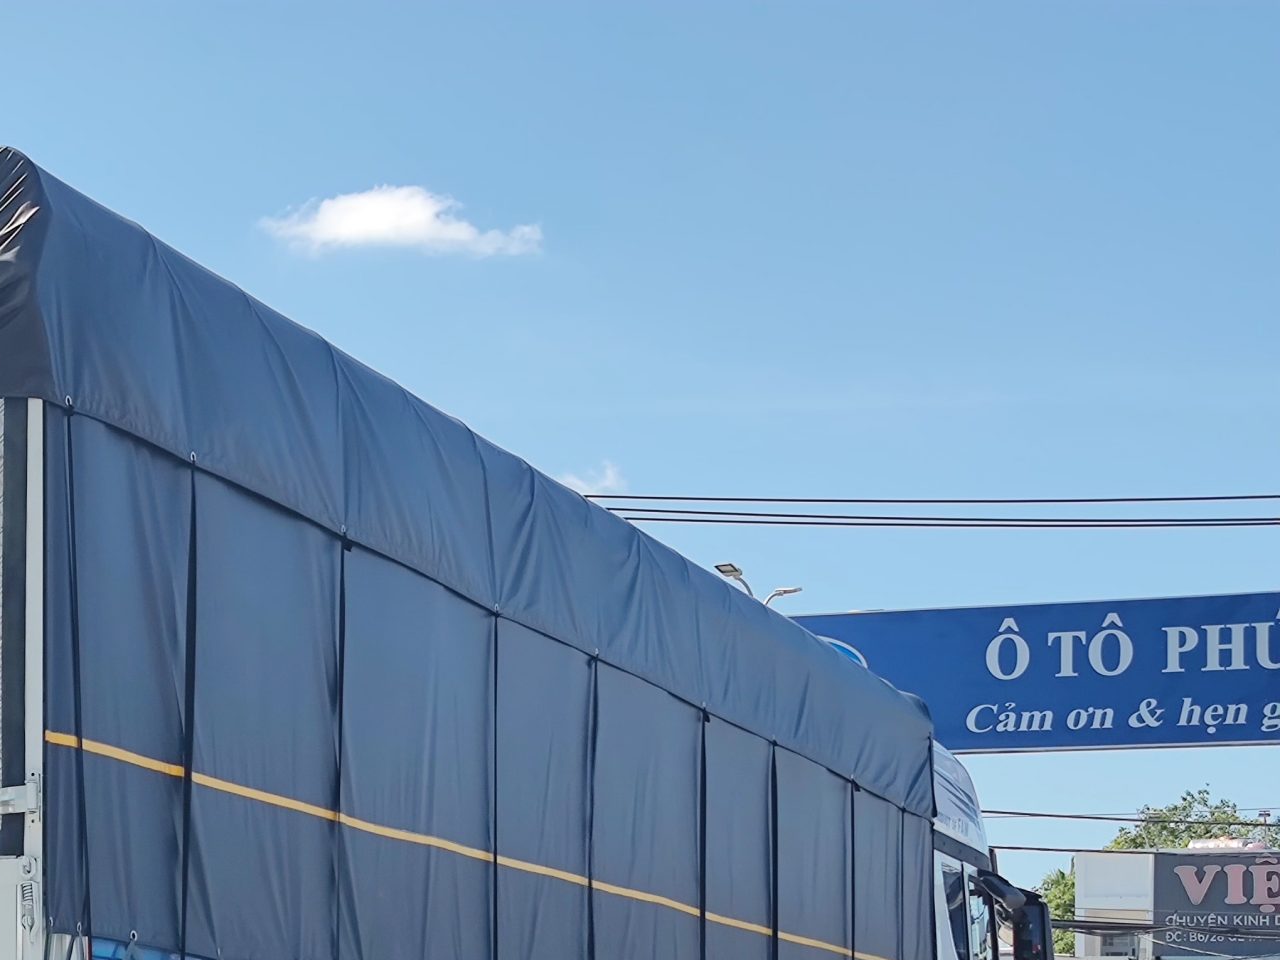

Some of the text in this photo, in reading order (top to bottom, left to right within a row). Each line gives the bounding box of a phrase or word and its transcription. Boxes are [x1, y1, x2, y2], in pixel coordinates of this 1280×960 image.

[985, 618, 1030, 681] Ô
[1047, 612, 1134, 678] TÔ
[965, 702, 1053, 733] Cảm
[1066, 706, 1114, 730] ơn
[1127, 698, 1165, 728] &
[1176, 697, 1248, 734] hẹn
[1165, 912, 1228, 926] CHUYÊN
[1233, 915, 1270, 926] KINH
